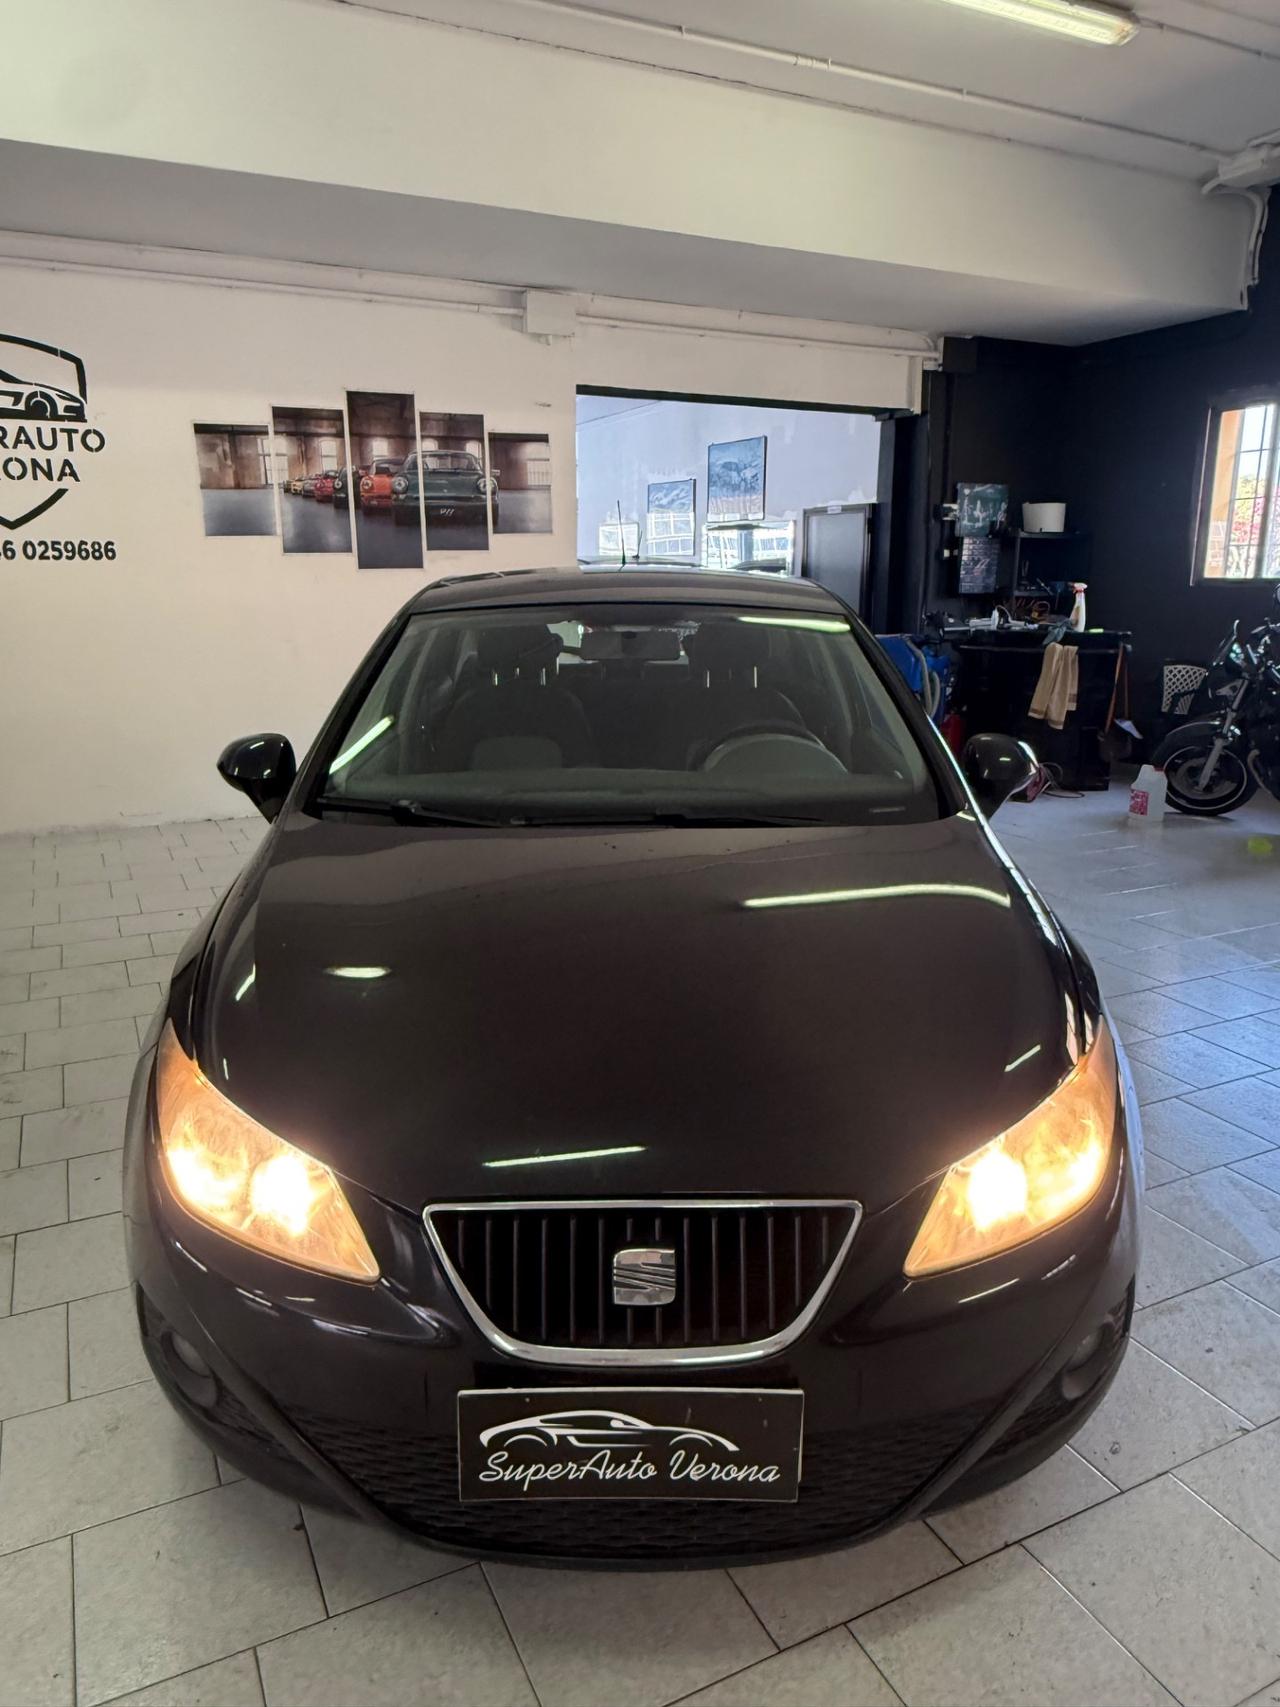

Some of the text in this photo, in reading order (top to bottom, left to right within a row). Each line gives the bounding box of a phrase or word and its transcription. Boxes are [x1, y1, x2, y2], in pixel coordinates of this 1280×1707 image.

[0, 456, 81, 483] ONA
[0, 539, 117, 561] 6 0259686
[478, 1449, 781, 1492] SuperAuto Verona
